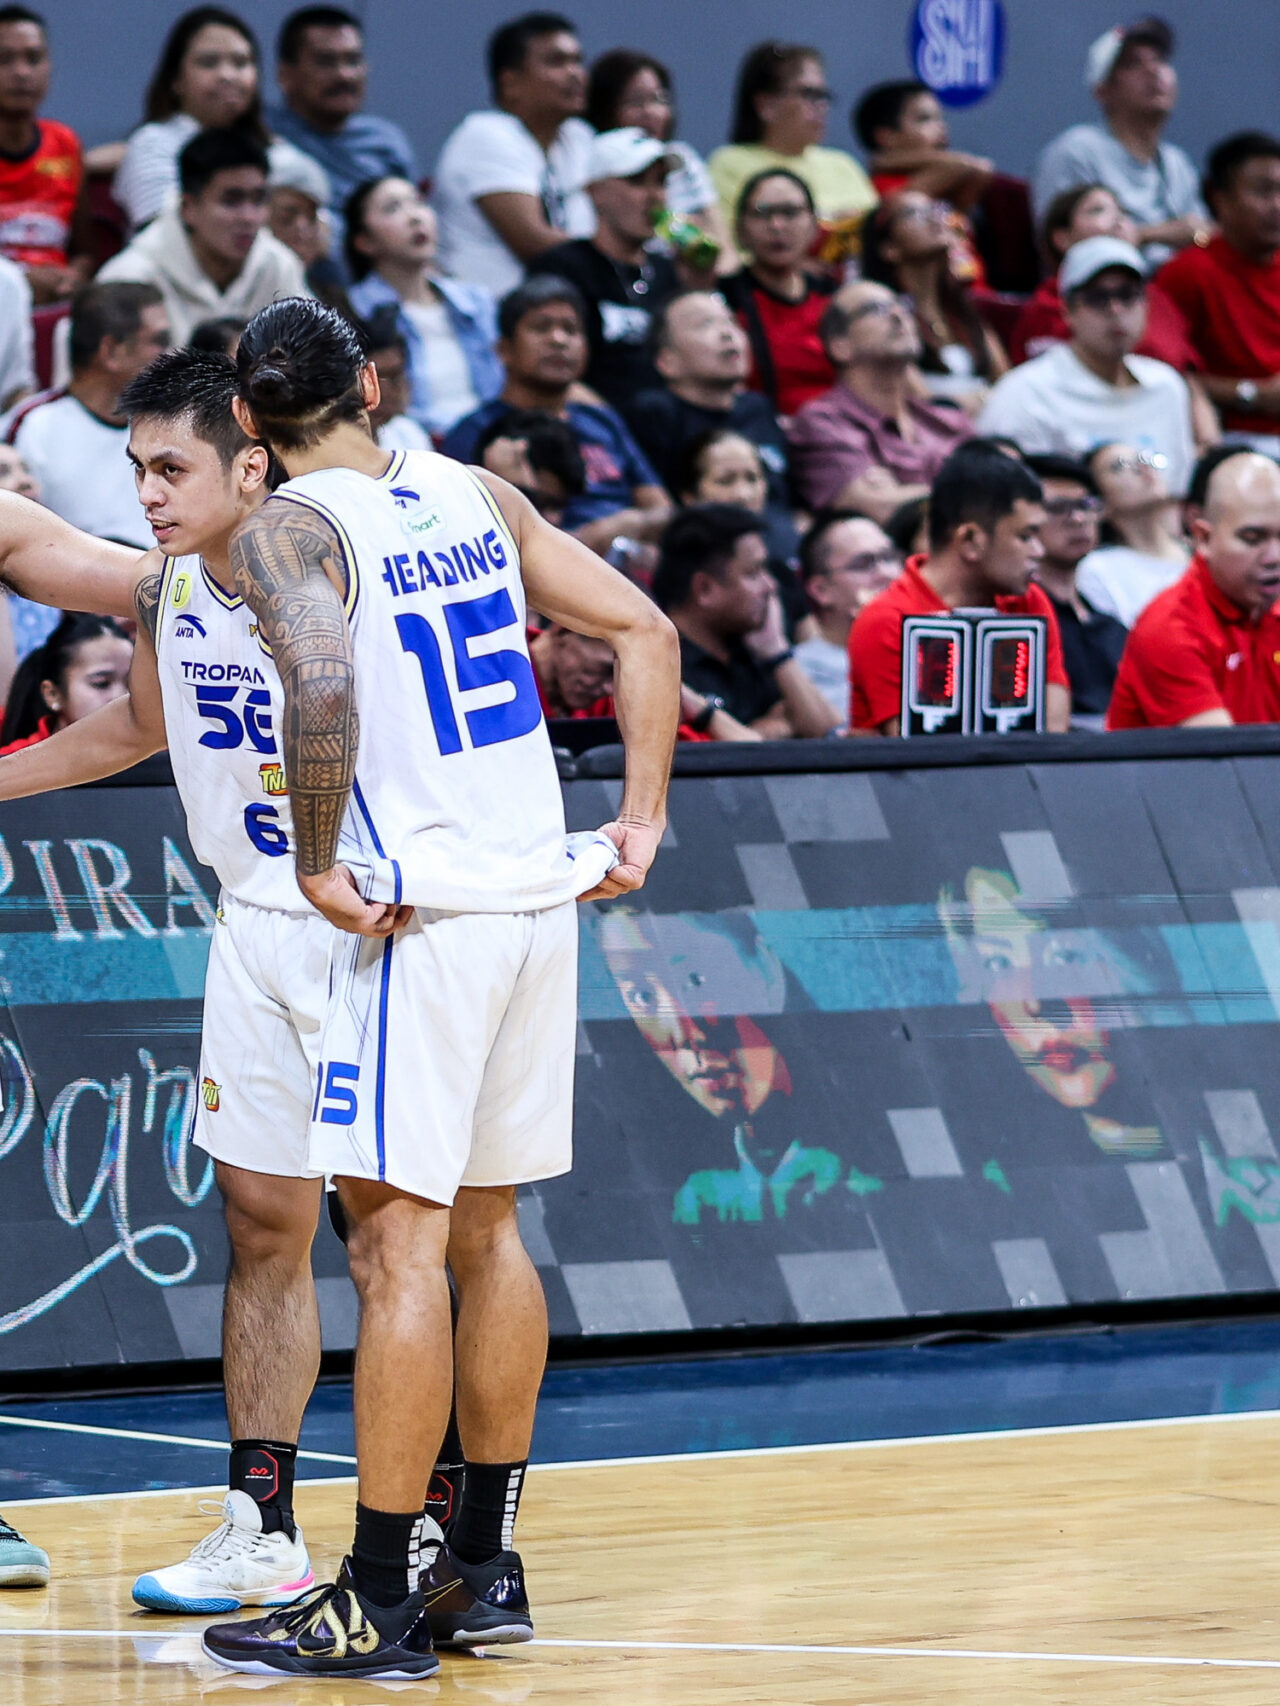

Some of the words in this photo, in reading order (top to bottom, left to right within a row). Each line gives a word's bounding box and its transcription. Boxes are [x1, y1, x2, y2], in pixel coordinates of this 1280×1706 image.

[175, 627, 194, 639] ANTA
[181, 661, 266, 685] TROPAN
[394, 587, 542, 756] 15
[244, 802, 289, 857] 6
